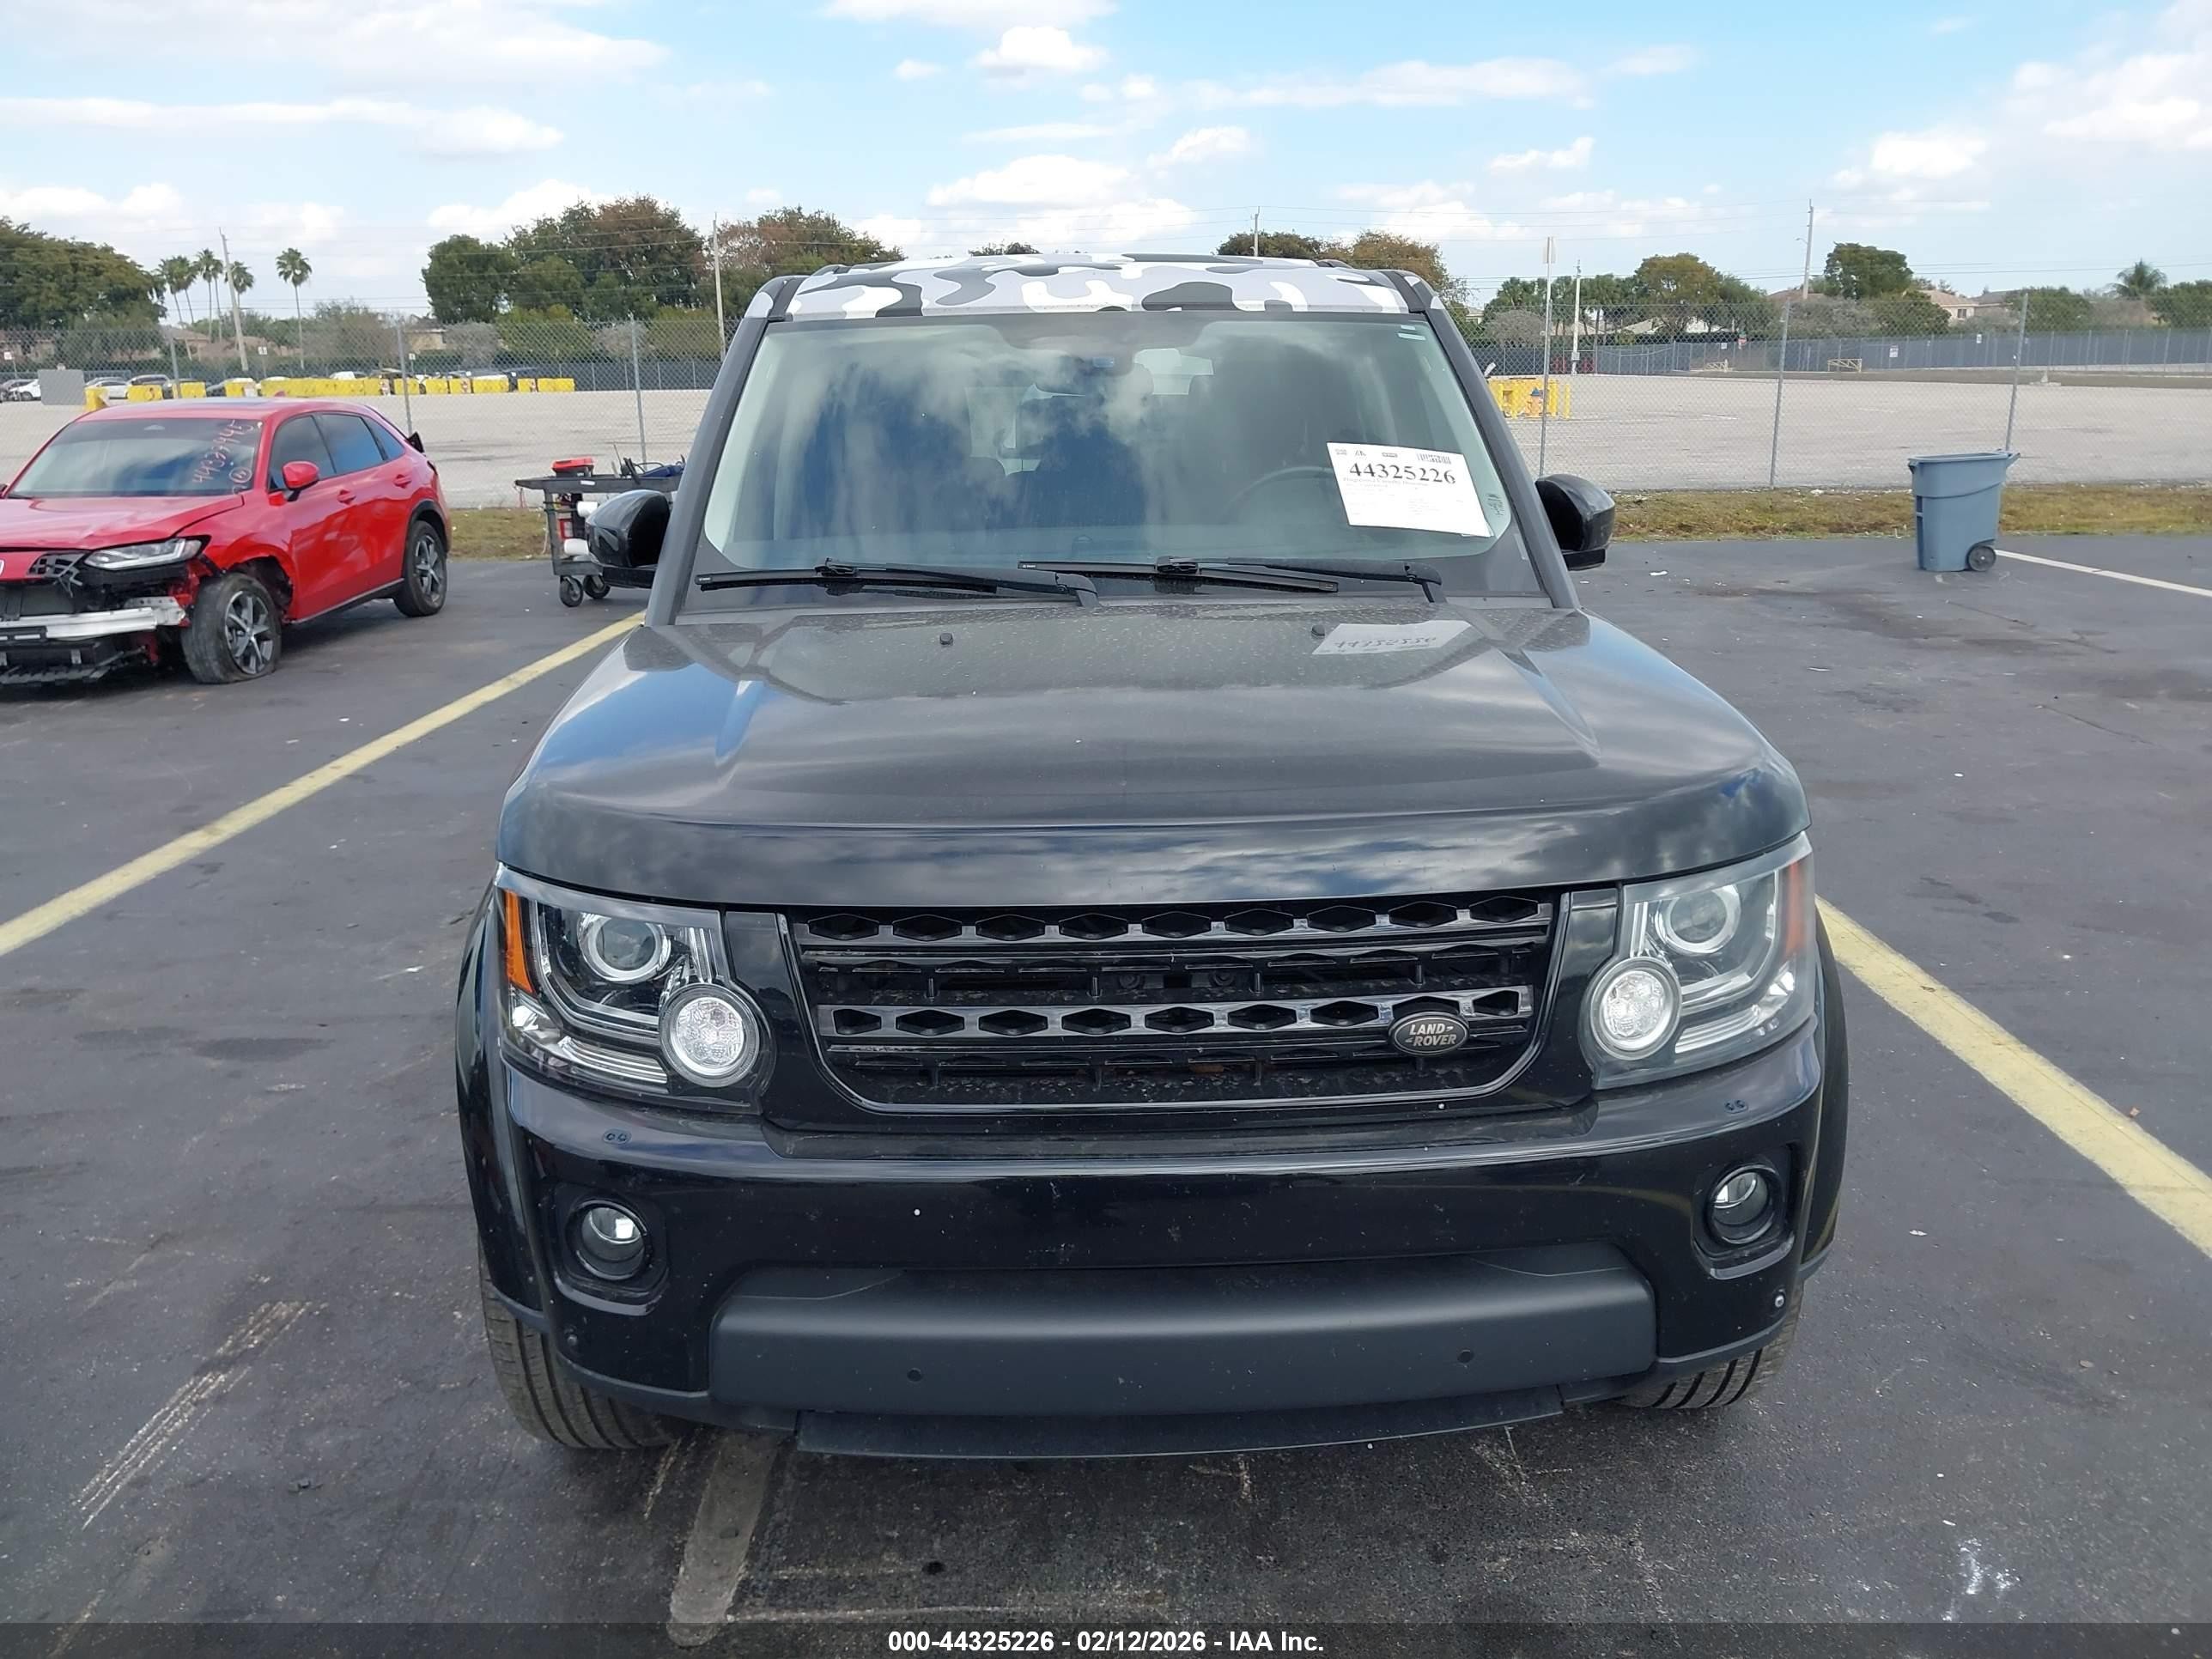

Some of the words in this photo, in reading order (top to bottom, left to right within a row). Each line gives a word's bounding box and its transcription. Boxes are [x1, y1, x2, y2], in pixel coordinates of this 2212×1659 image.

[1349, 462, 1456, 485] 44325226
[1409, 1024, 1446, 1036] LAND
[1413, 1034, 1457, 1047] ROVER
